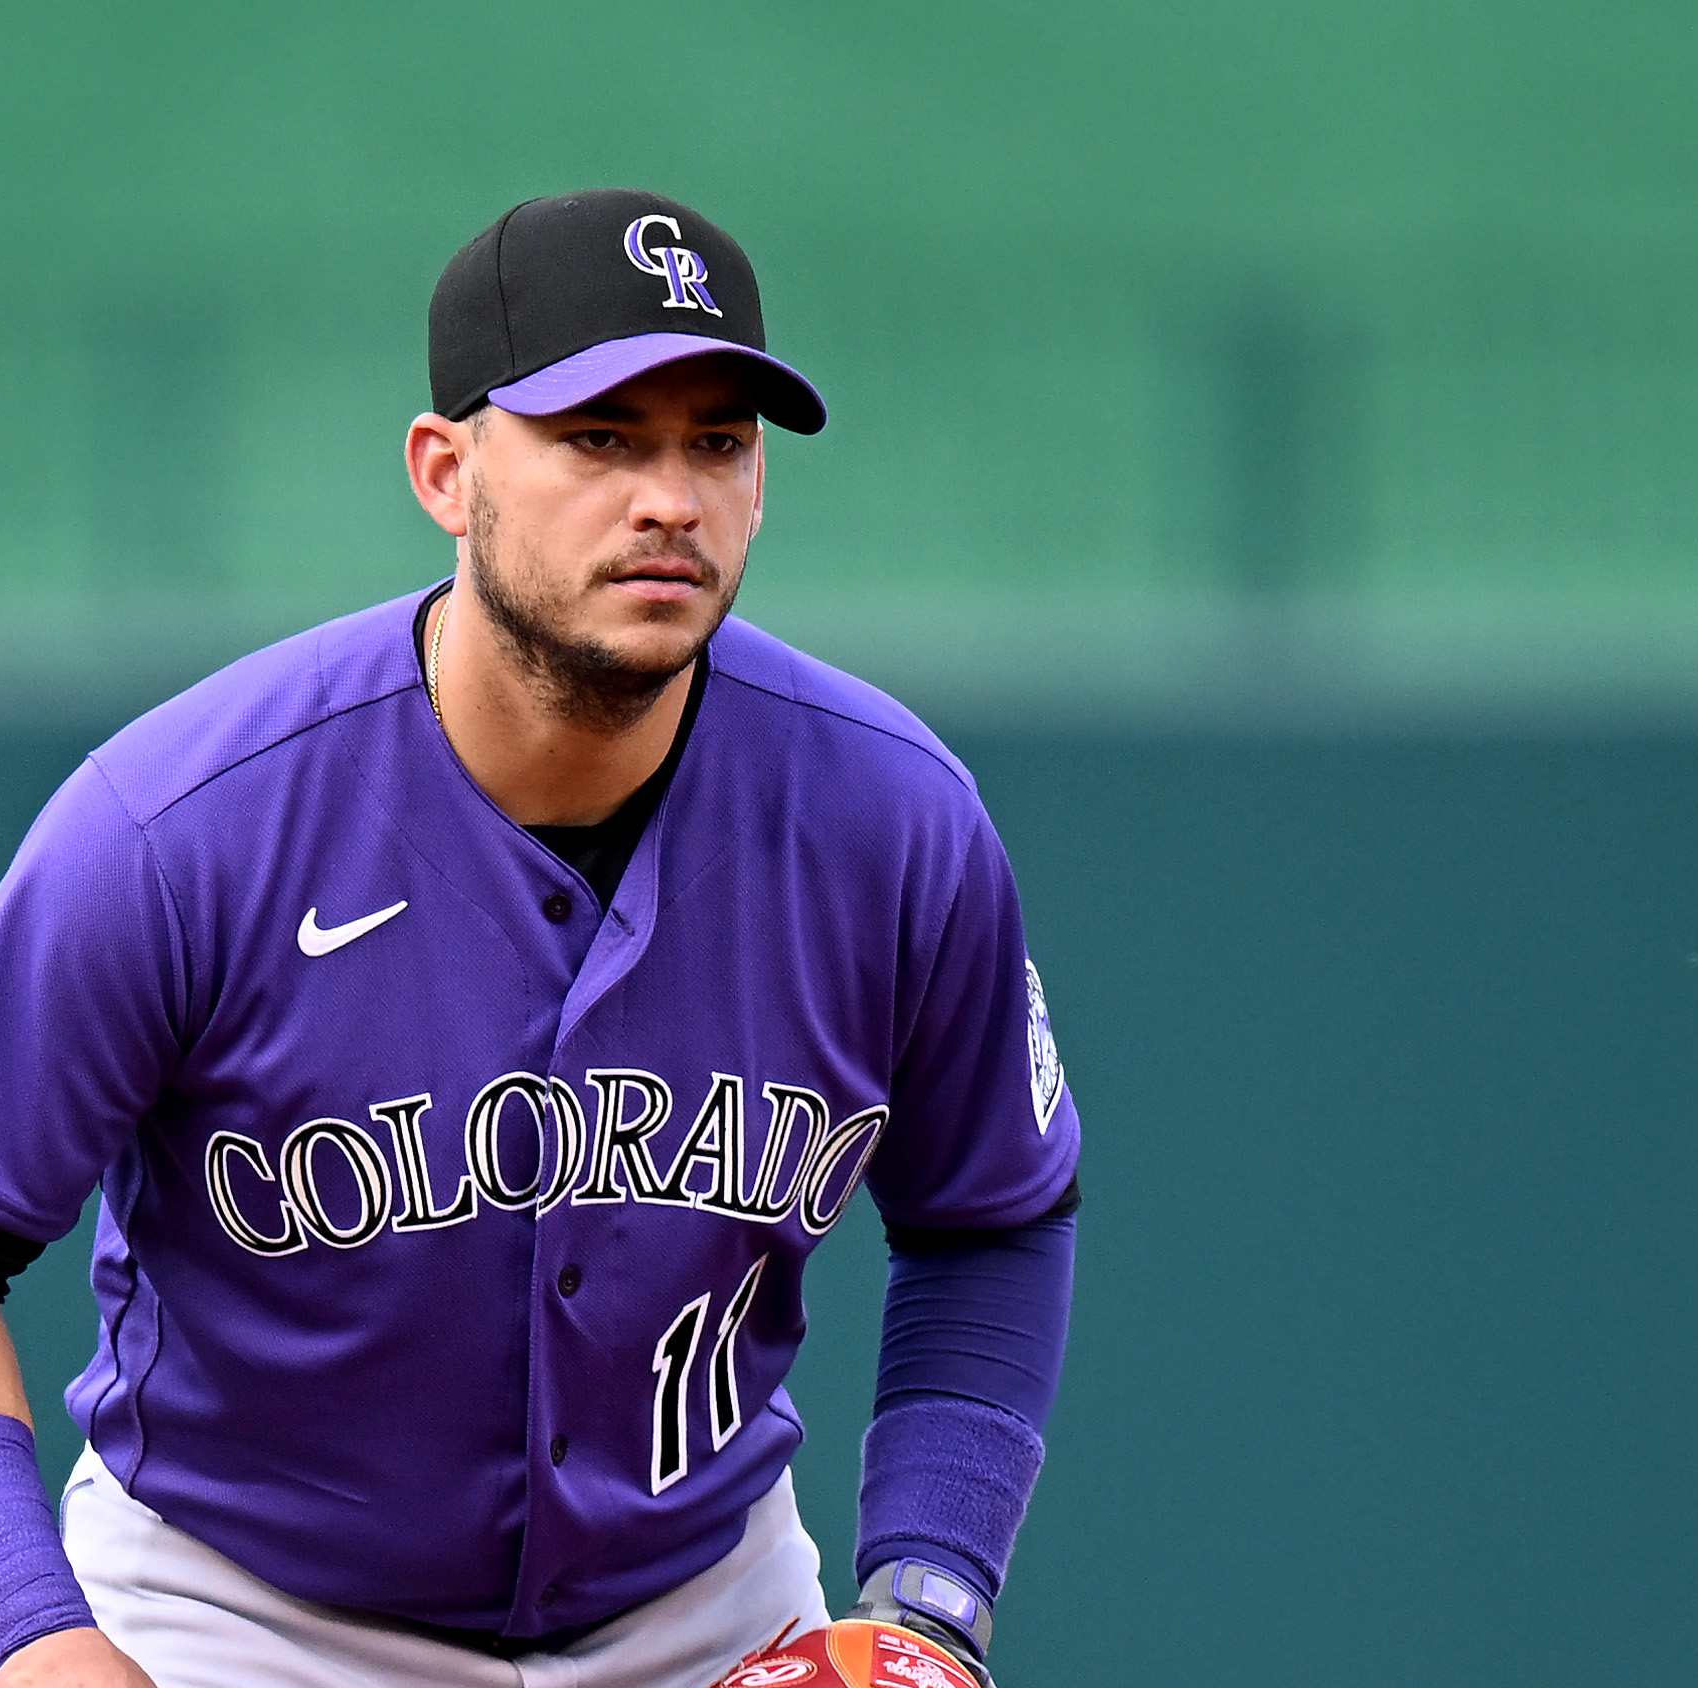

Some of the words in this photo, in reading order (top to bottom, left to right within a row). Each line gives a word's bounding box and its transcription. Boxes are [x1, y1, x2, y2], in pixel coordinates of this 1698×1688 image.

[623, 214, 723, 318] CR
[205, 1067, 890, 1258] COLORADO
[650, 1252, 769, 1497] 11
